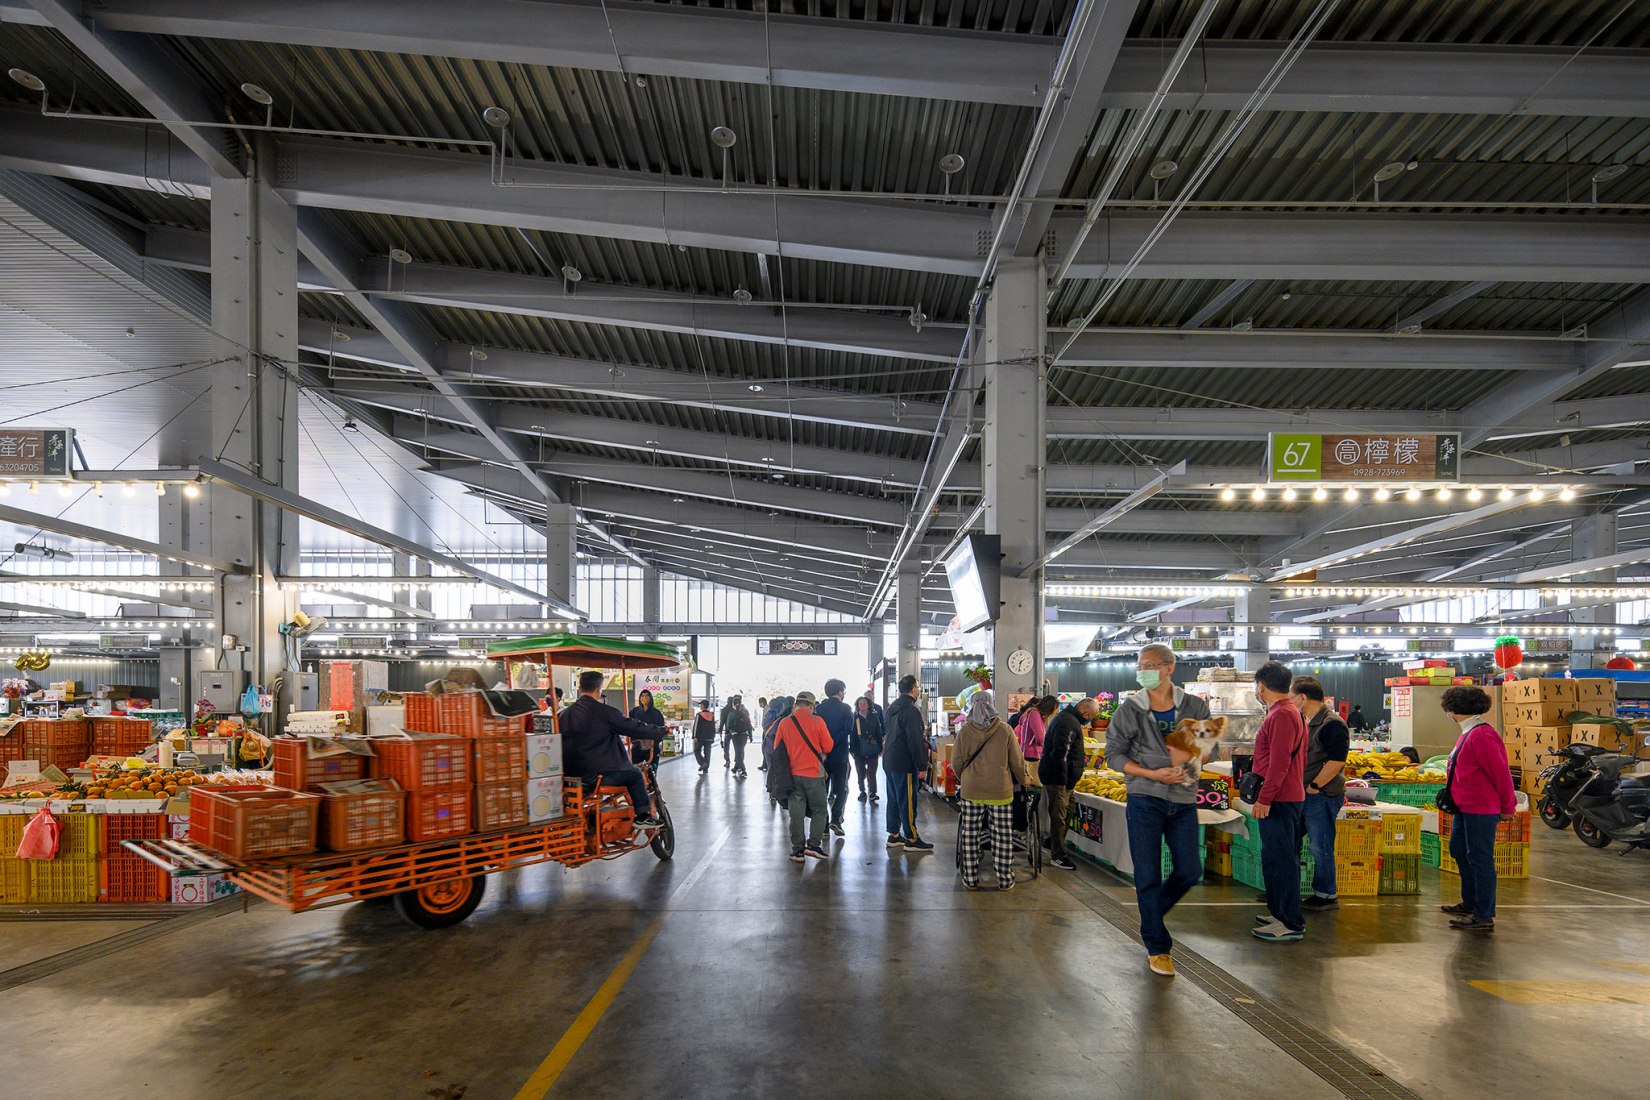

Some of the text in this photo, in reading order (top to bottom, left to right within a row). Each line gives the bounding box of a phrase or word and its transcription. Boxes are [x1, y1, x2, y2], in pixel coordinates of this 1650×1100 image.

[1282, 442, 1312, 467] 67
[1353, 468, 1406, 477] 0928-723969
[1174, 640, 1183, 648] 13
[1290, 640, 1299, 648] 12
[1527, 641, 1535, 649] 10
